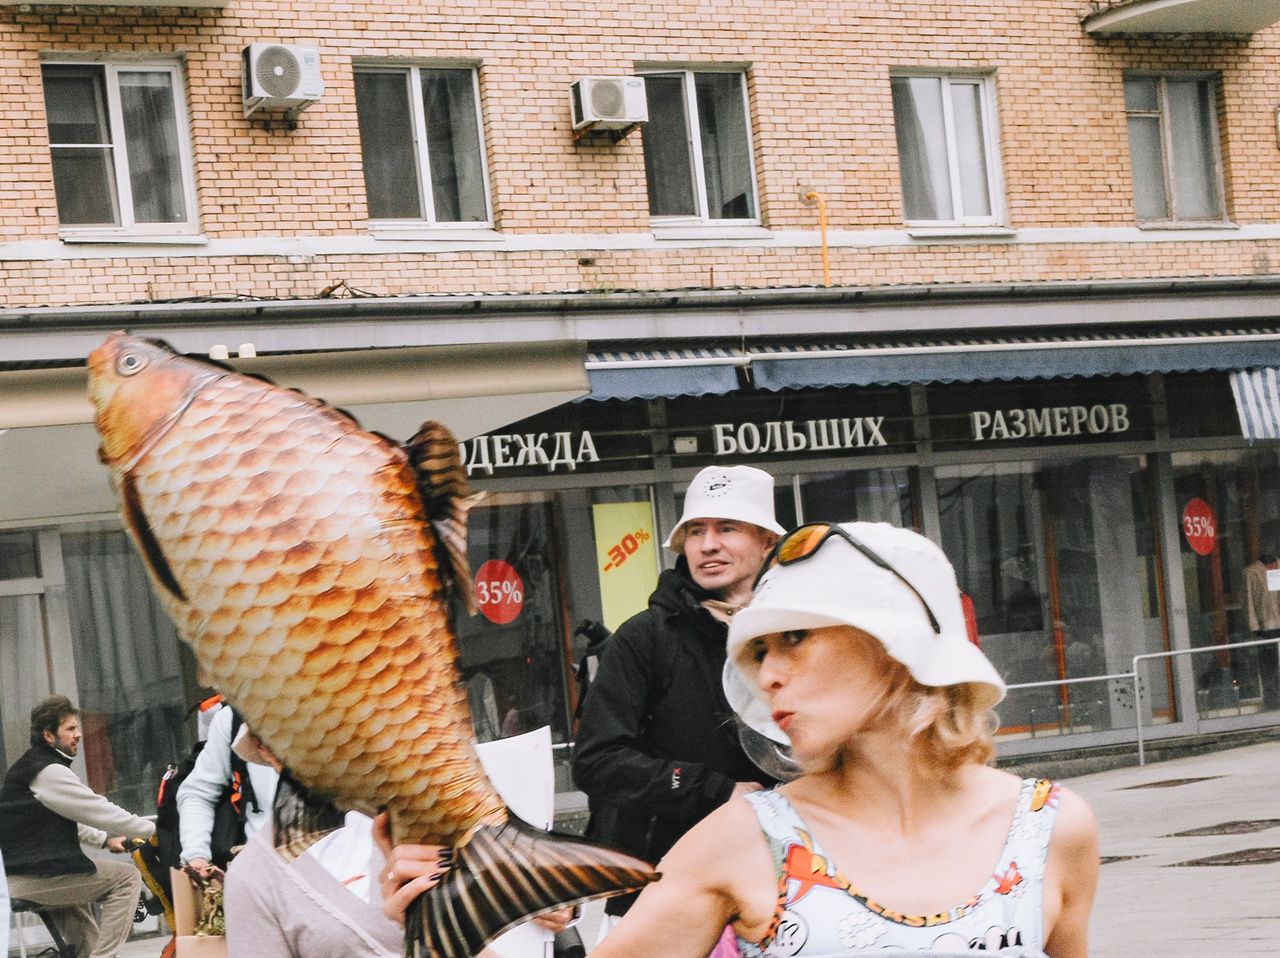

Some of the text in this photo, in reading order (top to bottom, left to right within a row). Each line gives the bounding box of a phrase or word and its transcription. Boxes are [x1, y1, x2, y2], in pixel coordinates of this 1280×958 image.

[713, 416, 888, 456] БОЛЬШИХ
[972, 403, 1130, 441] РАЗМЕРОВ
[1184, 515, 1215, 538] 35%
[603, 527, 650, 572] -30%
[477, 580, 523, 605] 35%
